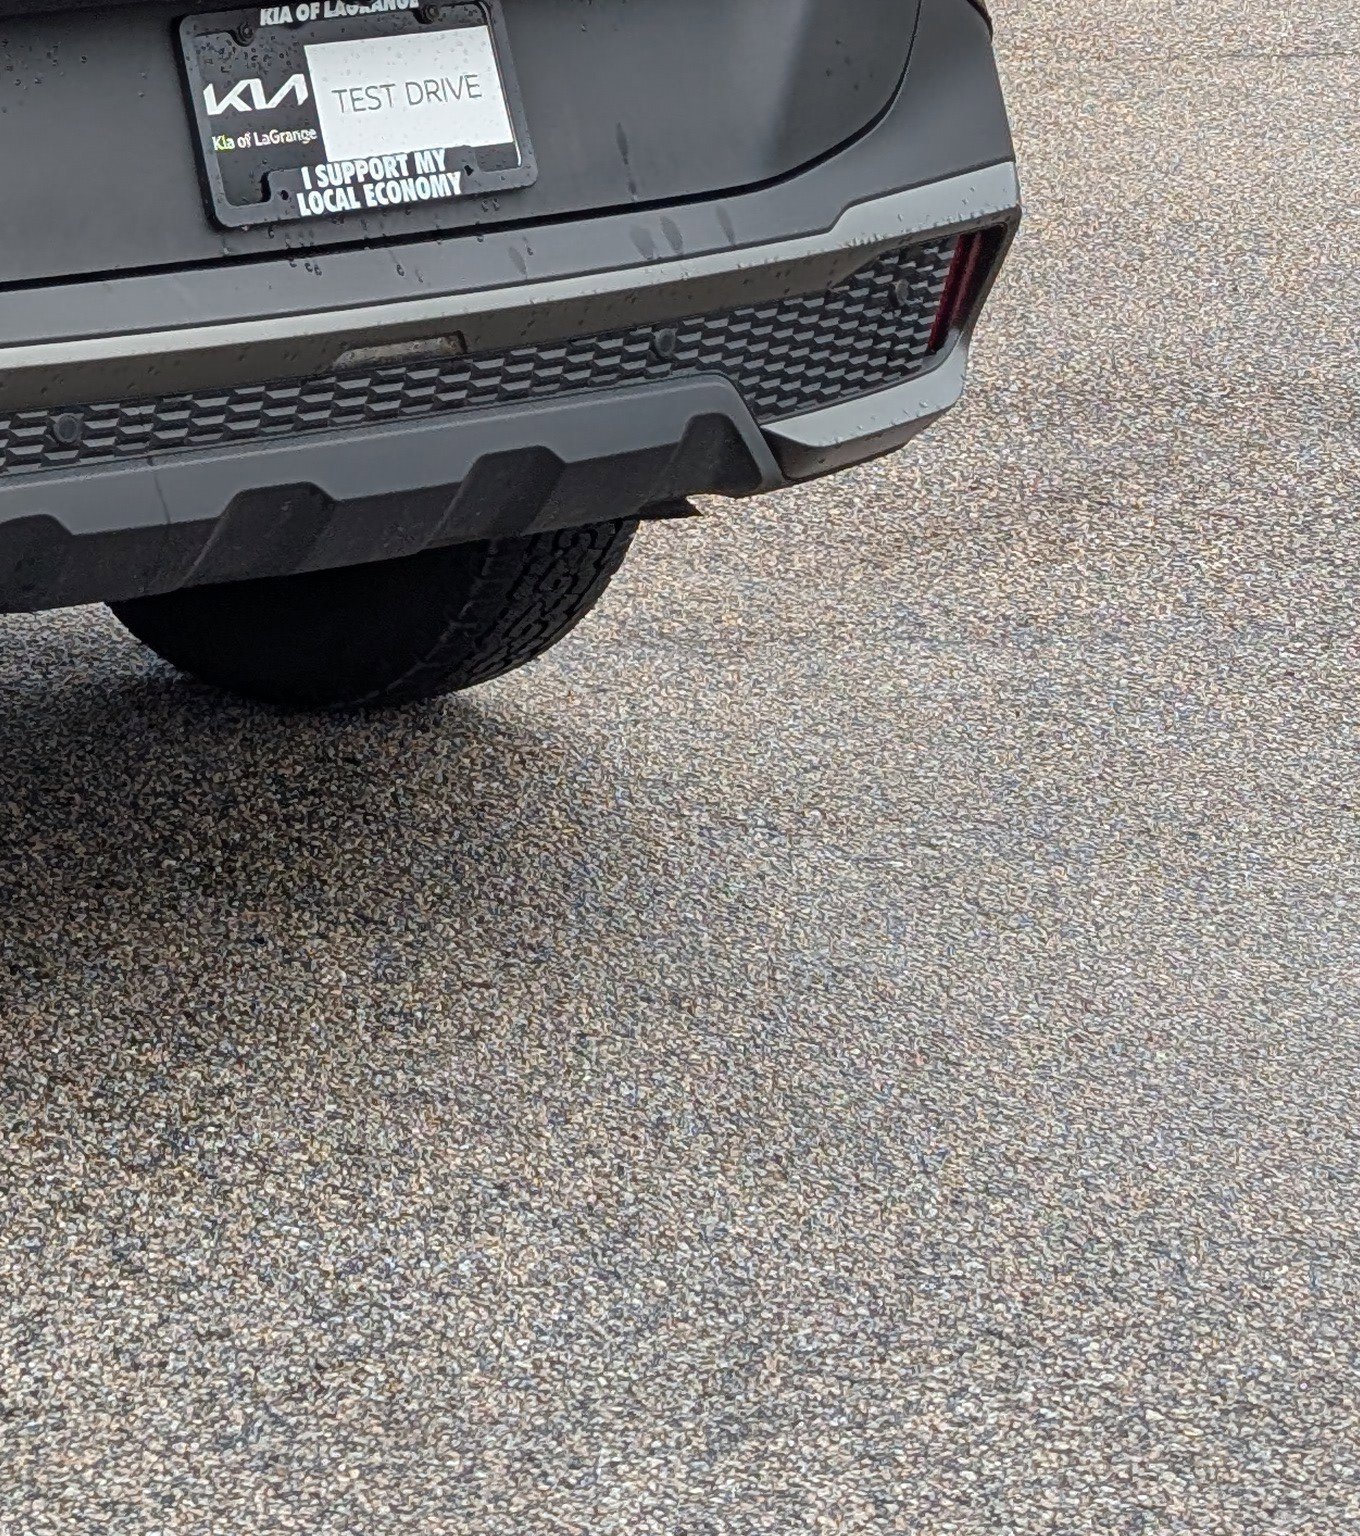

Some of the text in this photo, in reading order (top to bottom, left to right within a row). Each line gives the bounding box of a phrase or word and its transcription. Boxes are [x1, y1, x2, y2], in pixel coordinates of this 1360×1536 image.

[260, 5, 293, 26] KIA
[295, 2, 321, 22] OF
[202, 73, 309, 115] KIA
[332, 74, 483, 114] TEST DRIVE
[211, 128, 318, 151] Kia of LaGrange
[300, 147, 447, 190] I SUPPORT MY
[296, 172, 463, 217] LOCAL ECONOMY
